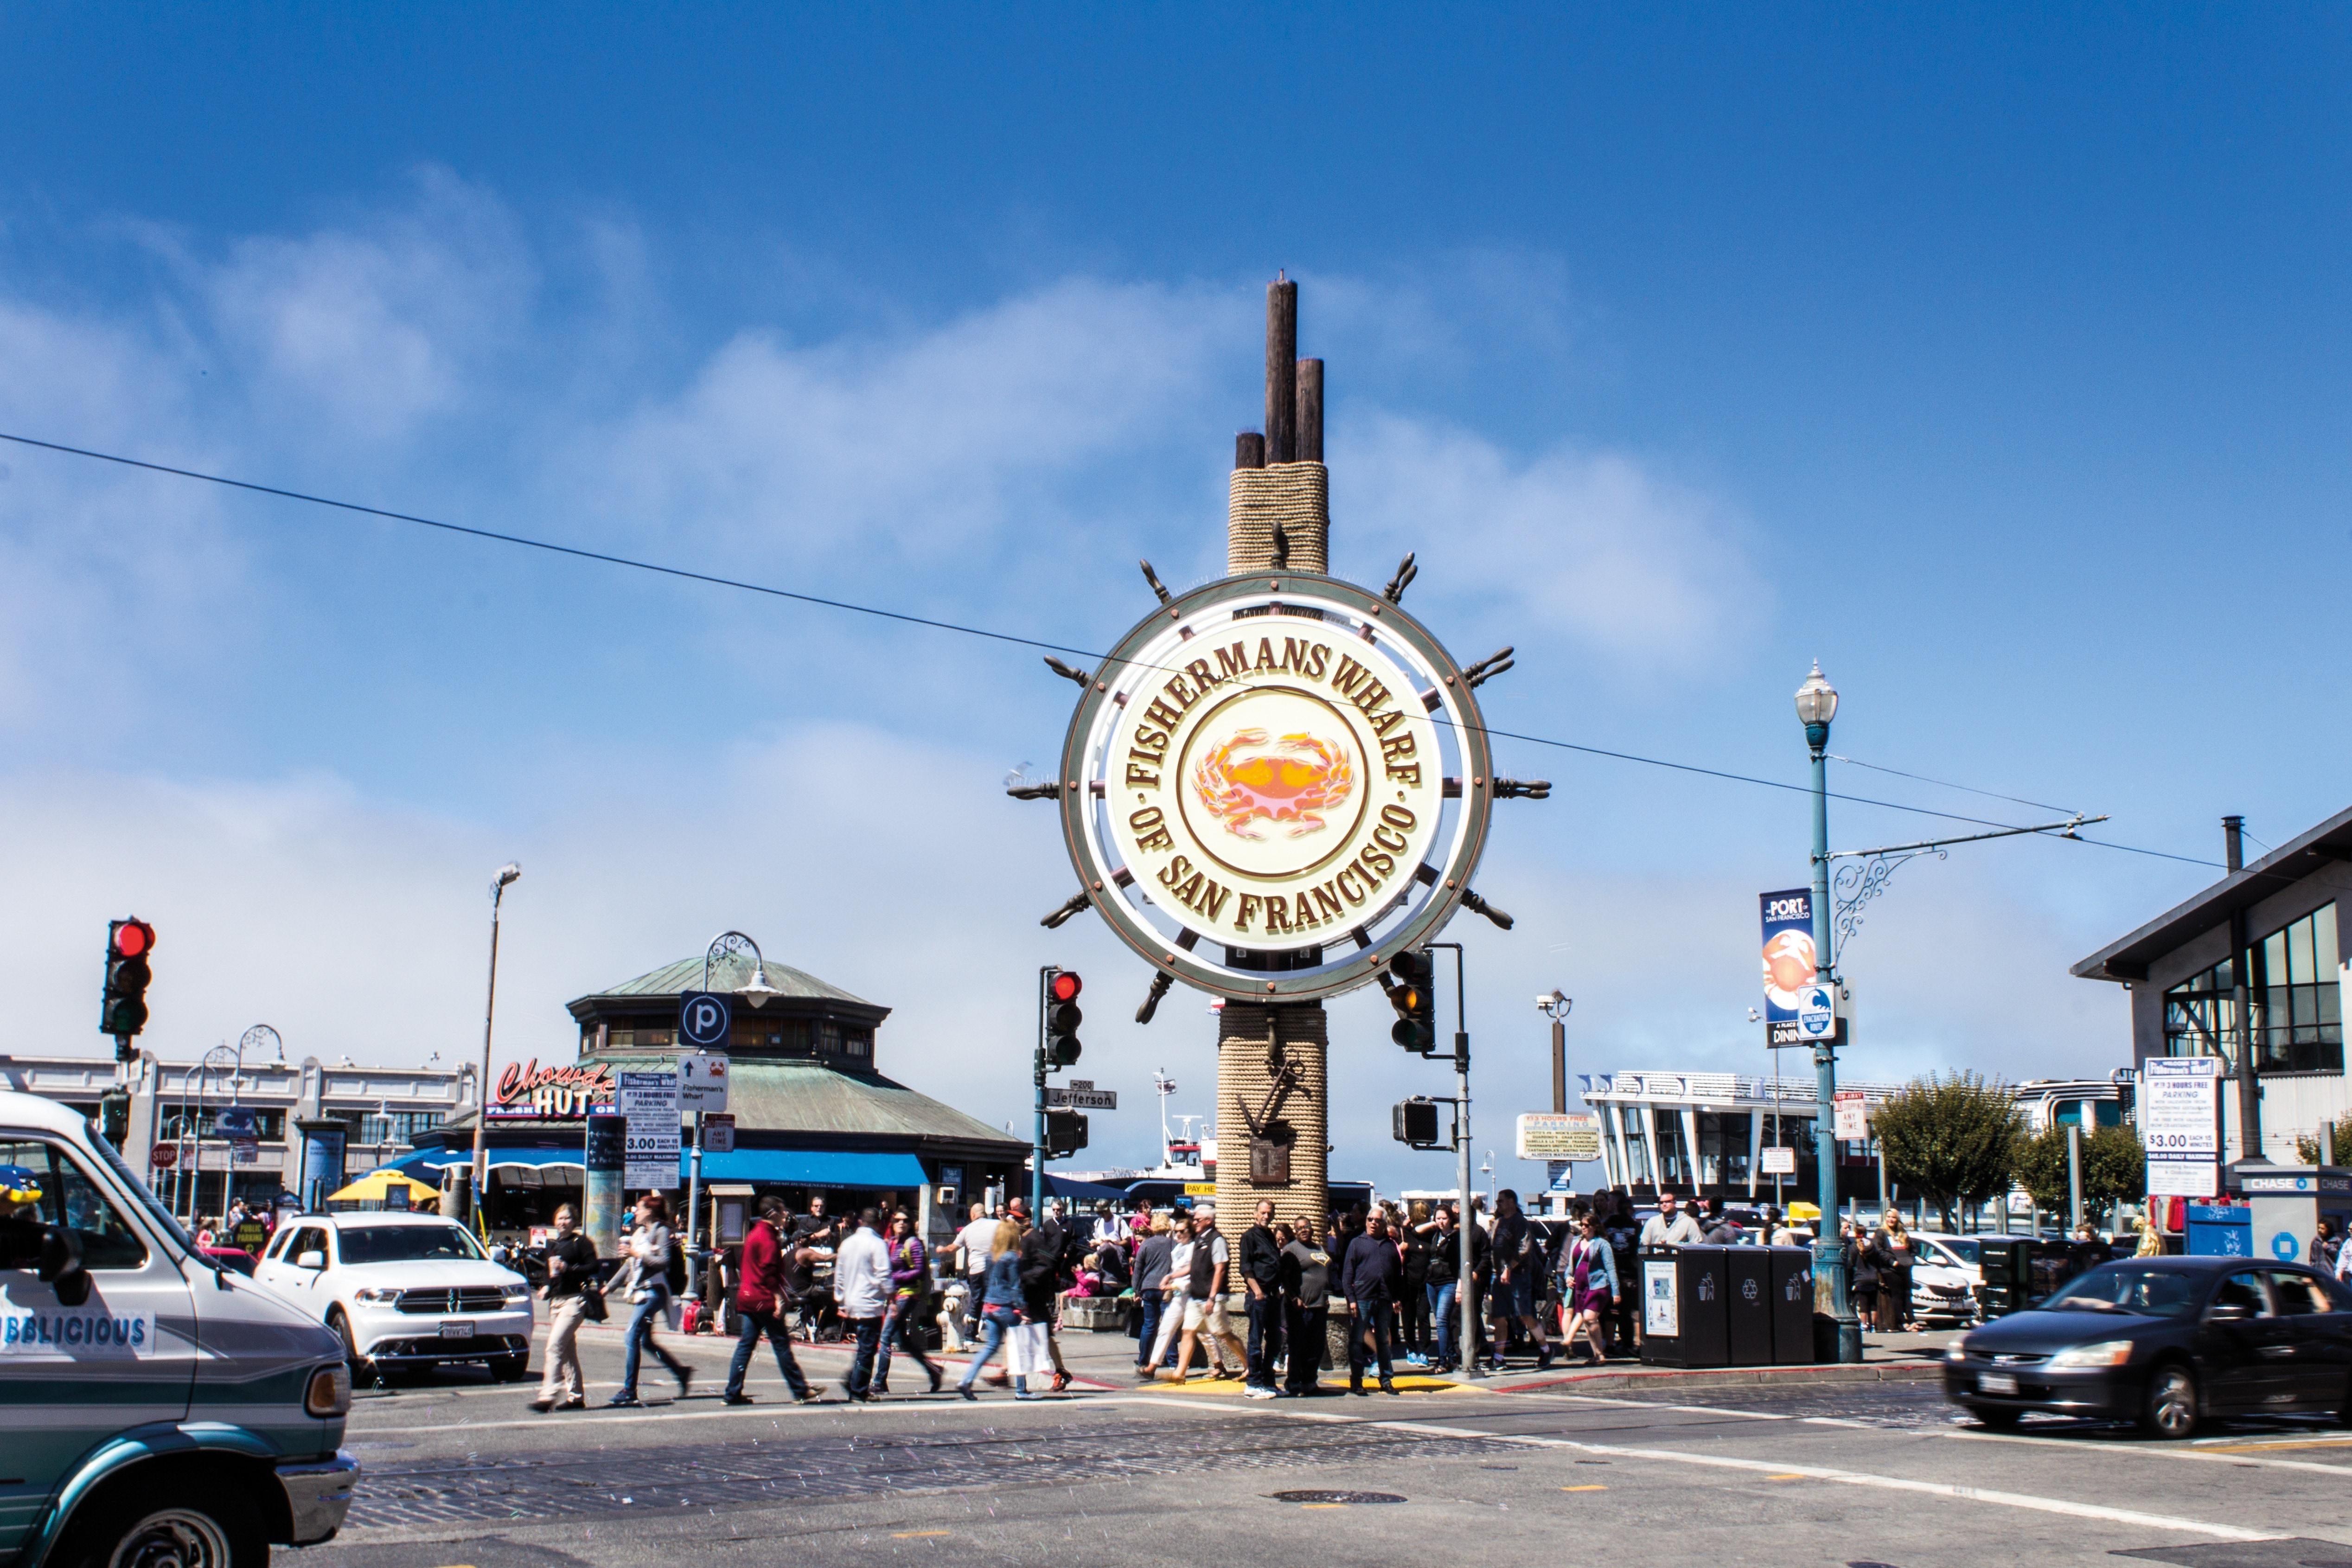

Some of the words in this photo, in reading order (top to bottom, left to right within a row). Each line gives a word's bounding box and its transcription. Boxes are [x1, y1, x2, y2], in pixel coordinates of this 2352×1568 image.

[1125, 637, 1332, 787] FISHERMANS
[1331, 653, 1422, 788] WHARF
[1129, 806, 1173, 854] OF
[1157, 854, 1232, 922] SAN
[1234, 803, 1416, 934] FRANCISCO
[1770, 898, 1804, 916] PORT
[1777, 912, 1810, 921] FRANCISCO
[1803, 1013, 1830, 1024] EVACUATION
[1810, 1023, 1823, 1031] ROUTE
[1773, 1029, 1800, 1043] DININ
[496, 1058, 616, 1104] Chowde
[683, 1084, 723, 1093] Fisherman's
[535, 1089, 593, 1115] HUT
[1054, 1093, 1111, 1105] Jefferson
[1843, 1122, 1858, 1130] TIME
[627, 1138, 656, 1149] 3.00
[2150, 1134, 2186, 1147] $3.00
[152, 1149, 176, 1162] STOP
[2250, 1178, 2294, 1189] CHASE
[2321, 1179, 2349, 1190] CHASE
[237, 1234, 263, 1242] PARKING
[0, 1317, 145, 1346] BBLICIOUS
